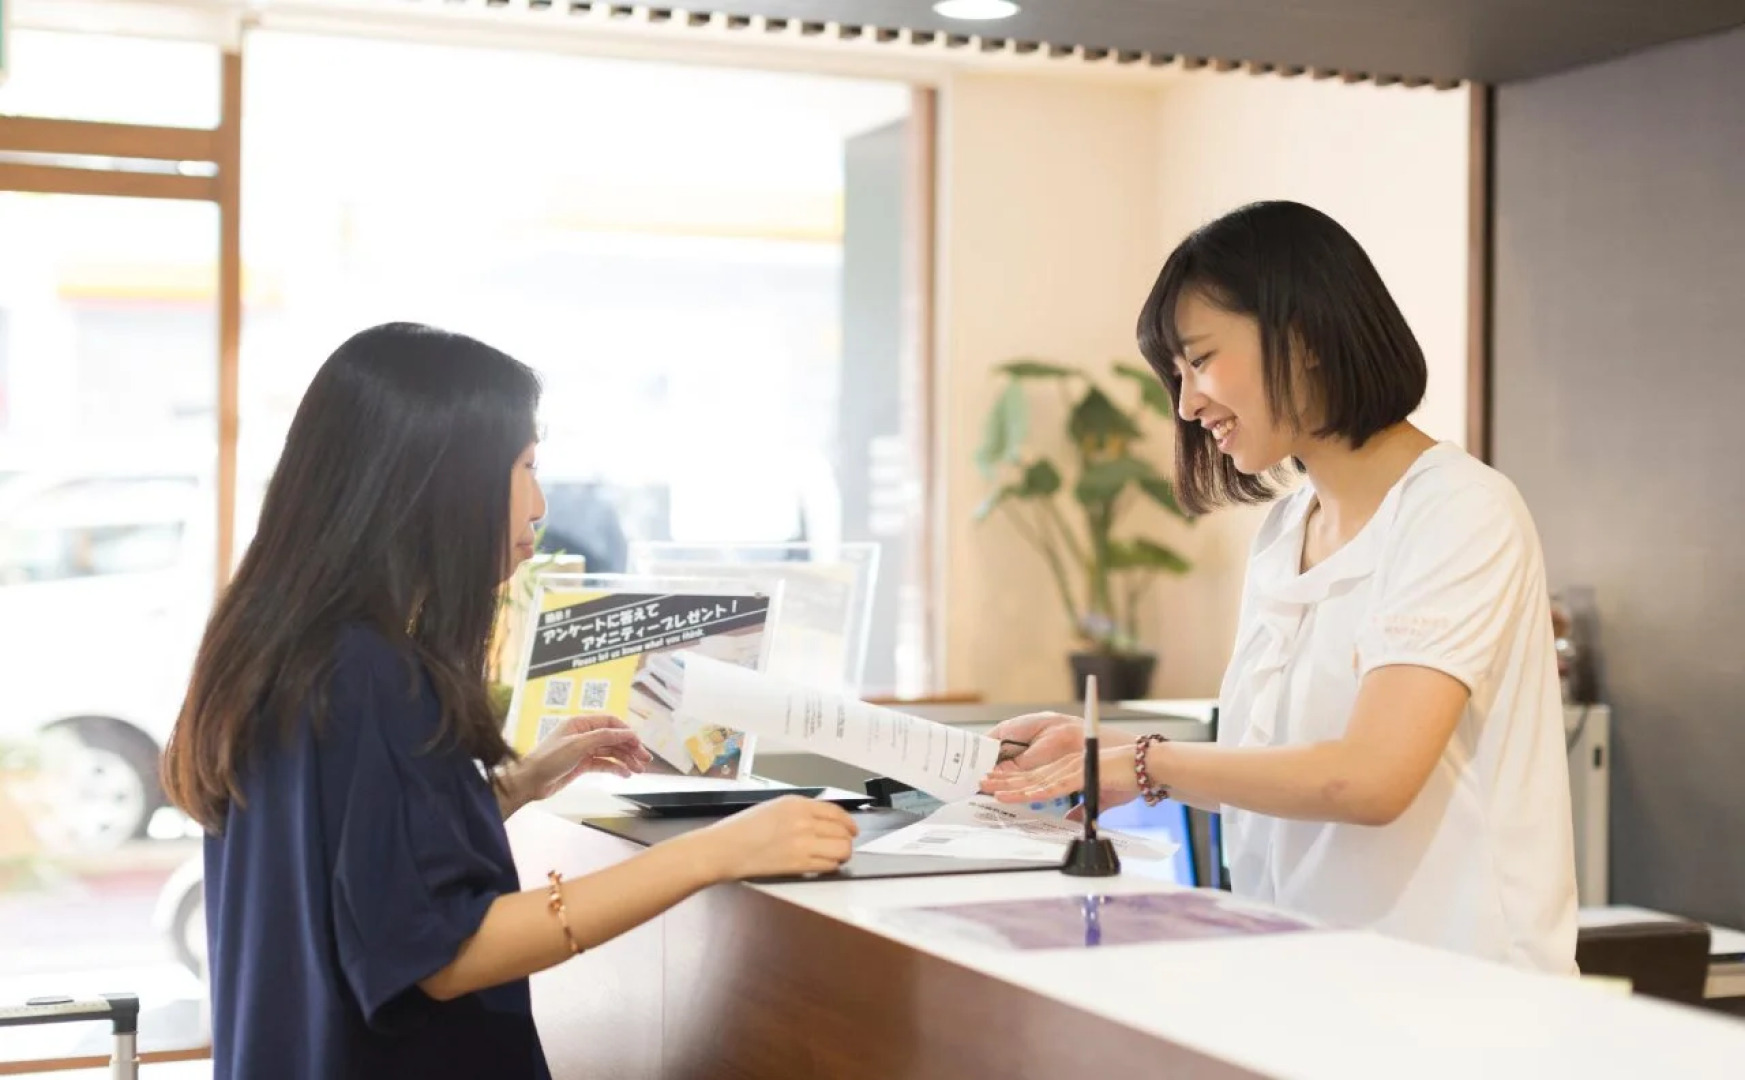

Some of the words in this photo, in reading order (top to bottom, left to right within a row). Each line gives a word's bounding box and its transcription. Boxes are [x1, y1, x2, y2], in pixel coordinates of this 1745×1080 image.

[543, 603, 660, 645] アンケートに答えて
[581, 599, 737, 651] アメニティープレゼント！
